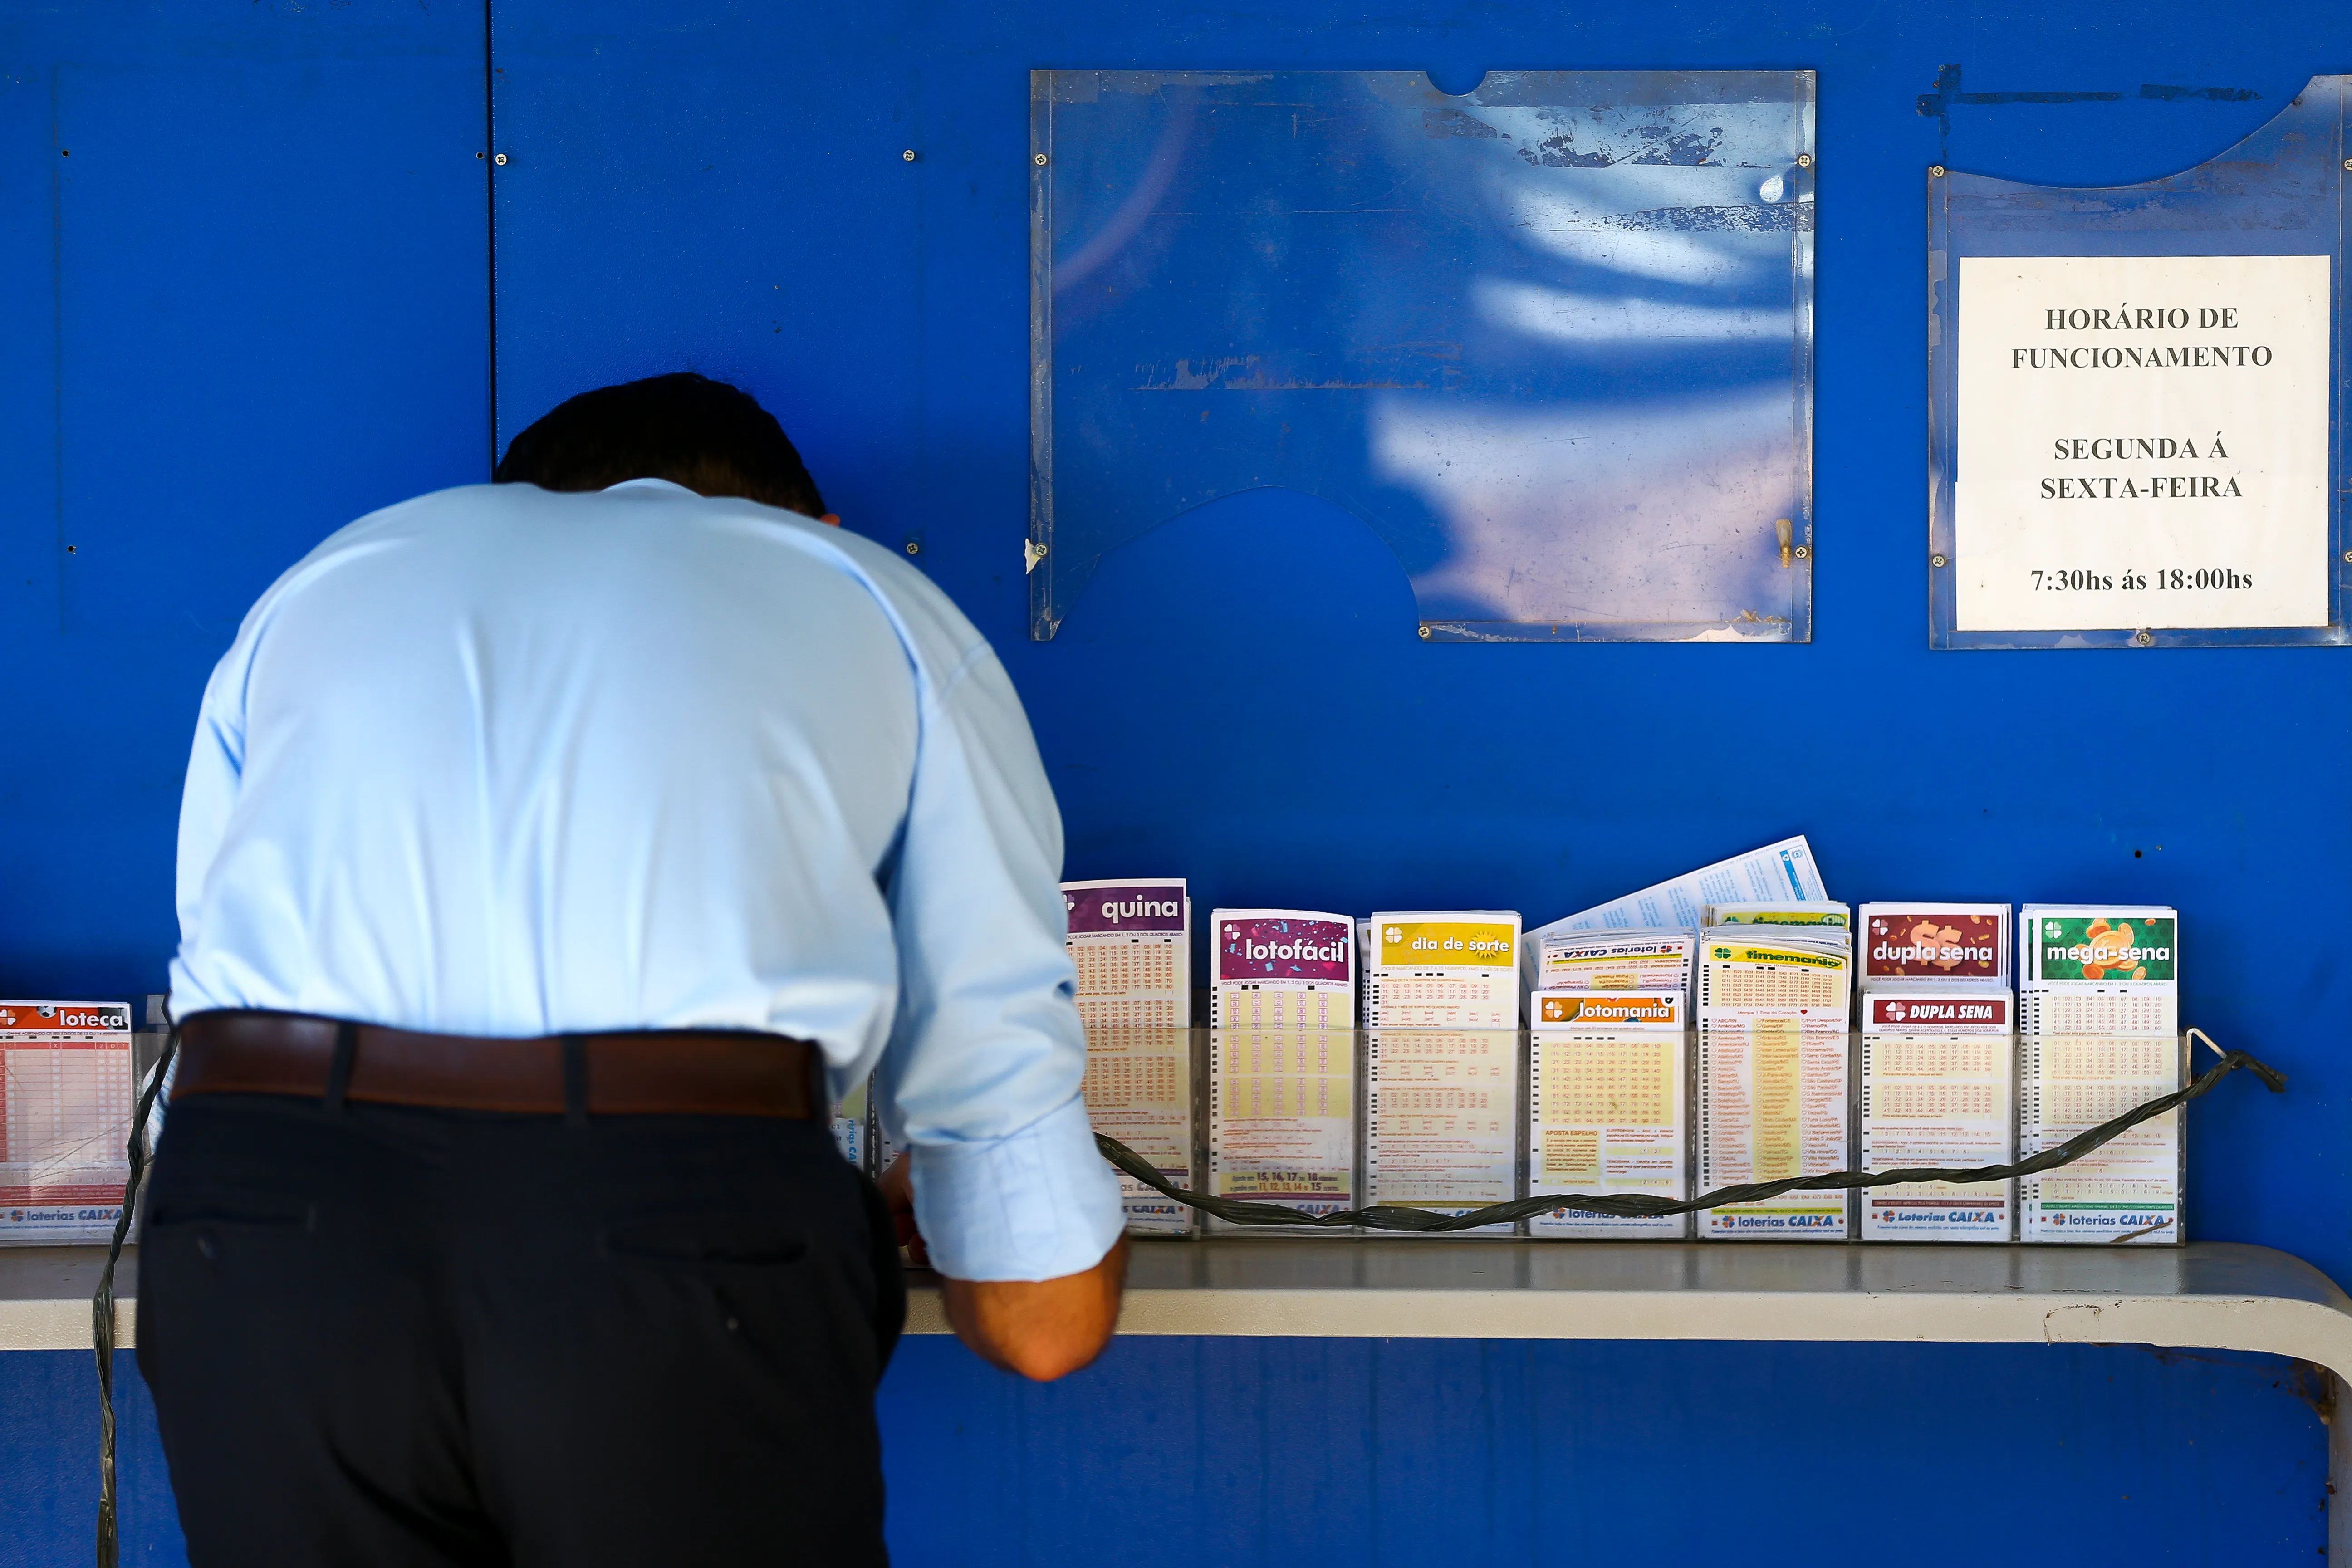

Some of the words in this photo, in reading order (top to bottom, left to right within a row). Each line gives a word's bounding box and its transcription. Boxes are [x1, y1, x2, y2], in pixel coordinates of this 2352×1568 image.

[2044, 303, 2190, 330] HORÁRIO
[2198, 308, 2239, 329] DE
[2011, 346, 2273, 369] FUNCIONAMENTO
[2054, 437, 2199, 460] SEGUNDA
[2208, 431, 2229, 459] Á
[2041, 476, 2243, 500] SEXTA-FEIRA
[2031, 569, 2112, 591] 7:30hs
[2122, 569, 2146, 590] ás
[2157, 568, 2252, 590] 18:00hs
[1101, 894, 1178, 924] quina
[1246, 938, 1344, 963] lotofácil
[1411, 937, 1438, 951] dia
[1443, 936, 1464, 951] de
[1468, 939, 1510, 952] sorte
[1611, 946, 1656, 955] loterias
[1564, 948, 1608, 958] CAIXA
[1746, 950, 1841, 967] timemania
[1873, 941, 1937, 965] dupla
[1940, 946, 1993, 960] sena
[2047, 946, 2170, 965] mega-sena
[59, 1009, 123, 1027] loteca
[1578, 1002, 1670, 1018] lotomania
[1910, 1005, 1955, 1019] DUPLA
[1958, 1005, 1993, 1019] SENA
[1257, 1172, 1269, 1182] 15,
[1272, 1172, 1284, 1182] 16,
[1287, 1172, 1297, 1181] 17
[1311, 1182, 1321, 1191] 15
[27, 1210, 75, 1221] loterias
[1132, 1205, 1176, 1214] CAIXA
[1898, 1212, 1945, 1222] Loterias
[1949, 1212, 1995, 1223] CAIXA
[1738, 1217, 1785, 1228] loterias
[1788, 1216, 1833, 1227] CAIXA
[2069, 1215, 2116, 1225] loterias
[2120, 1215, 2164, 1225] CAIXA
